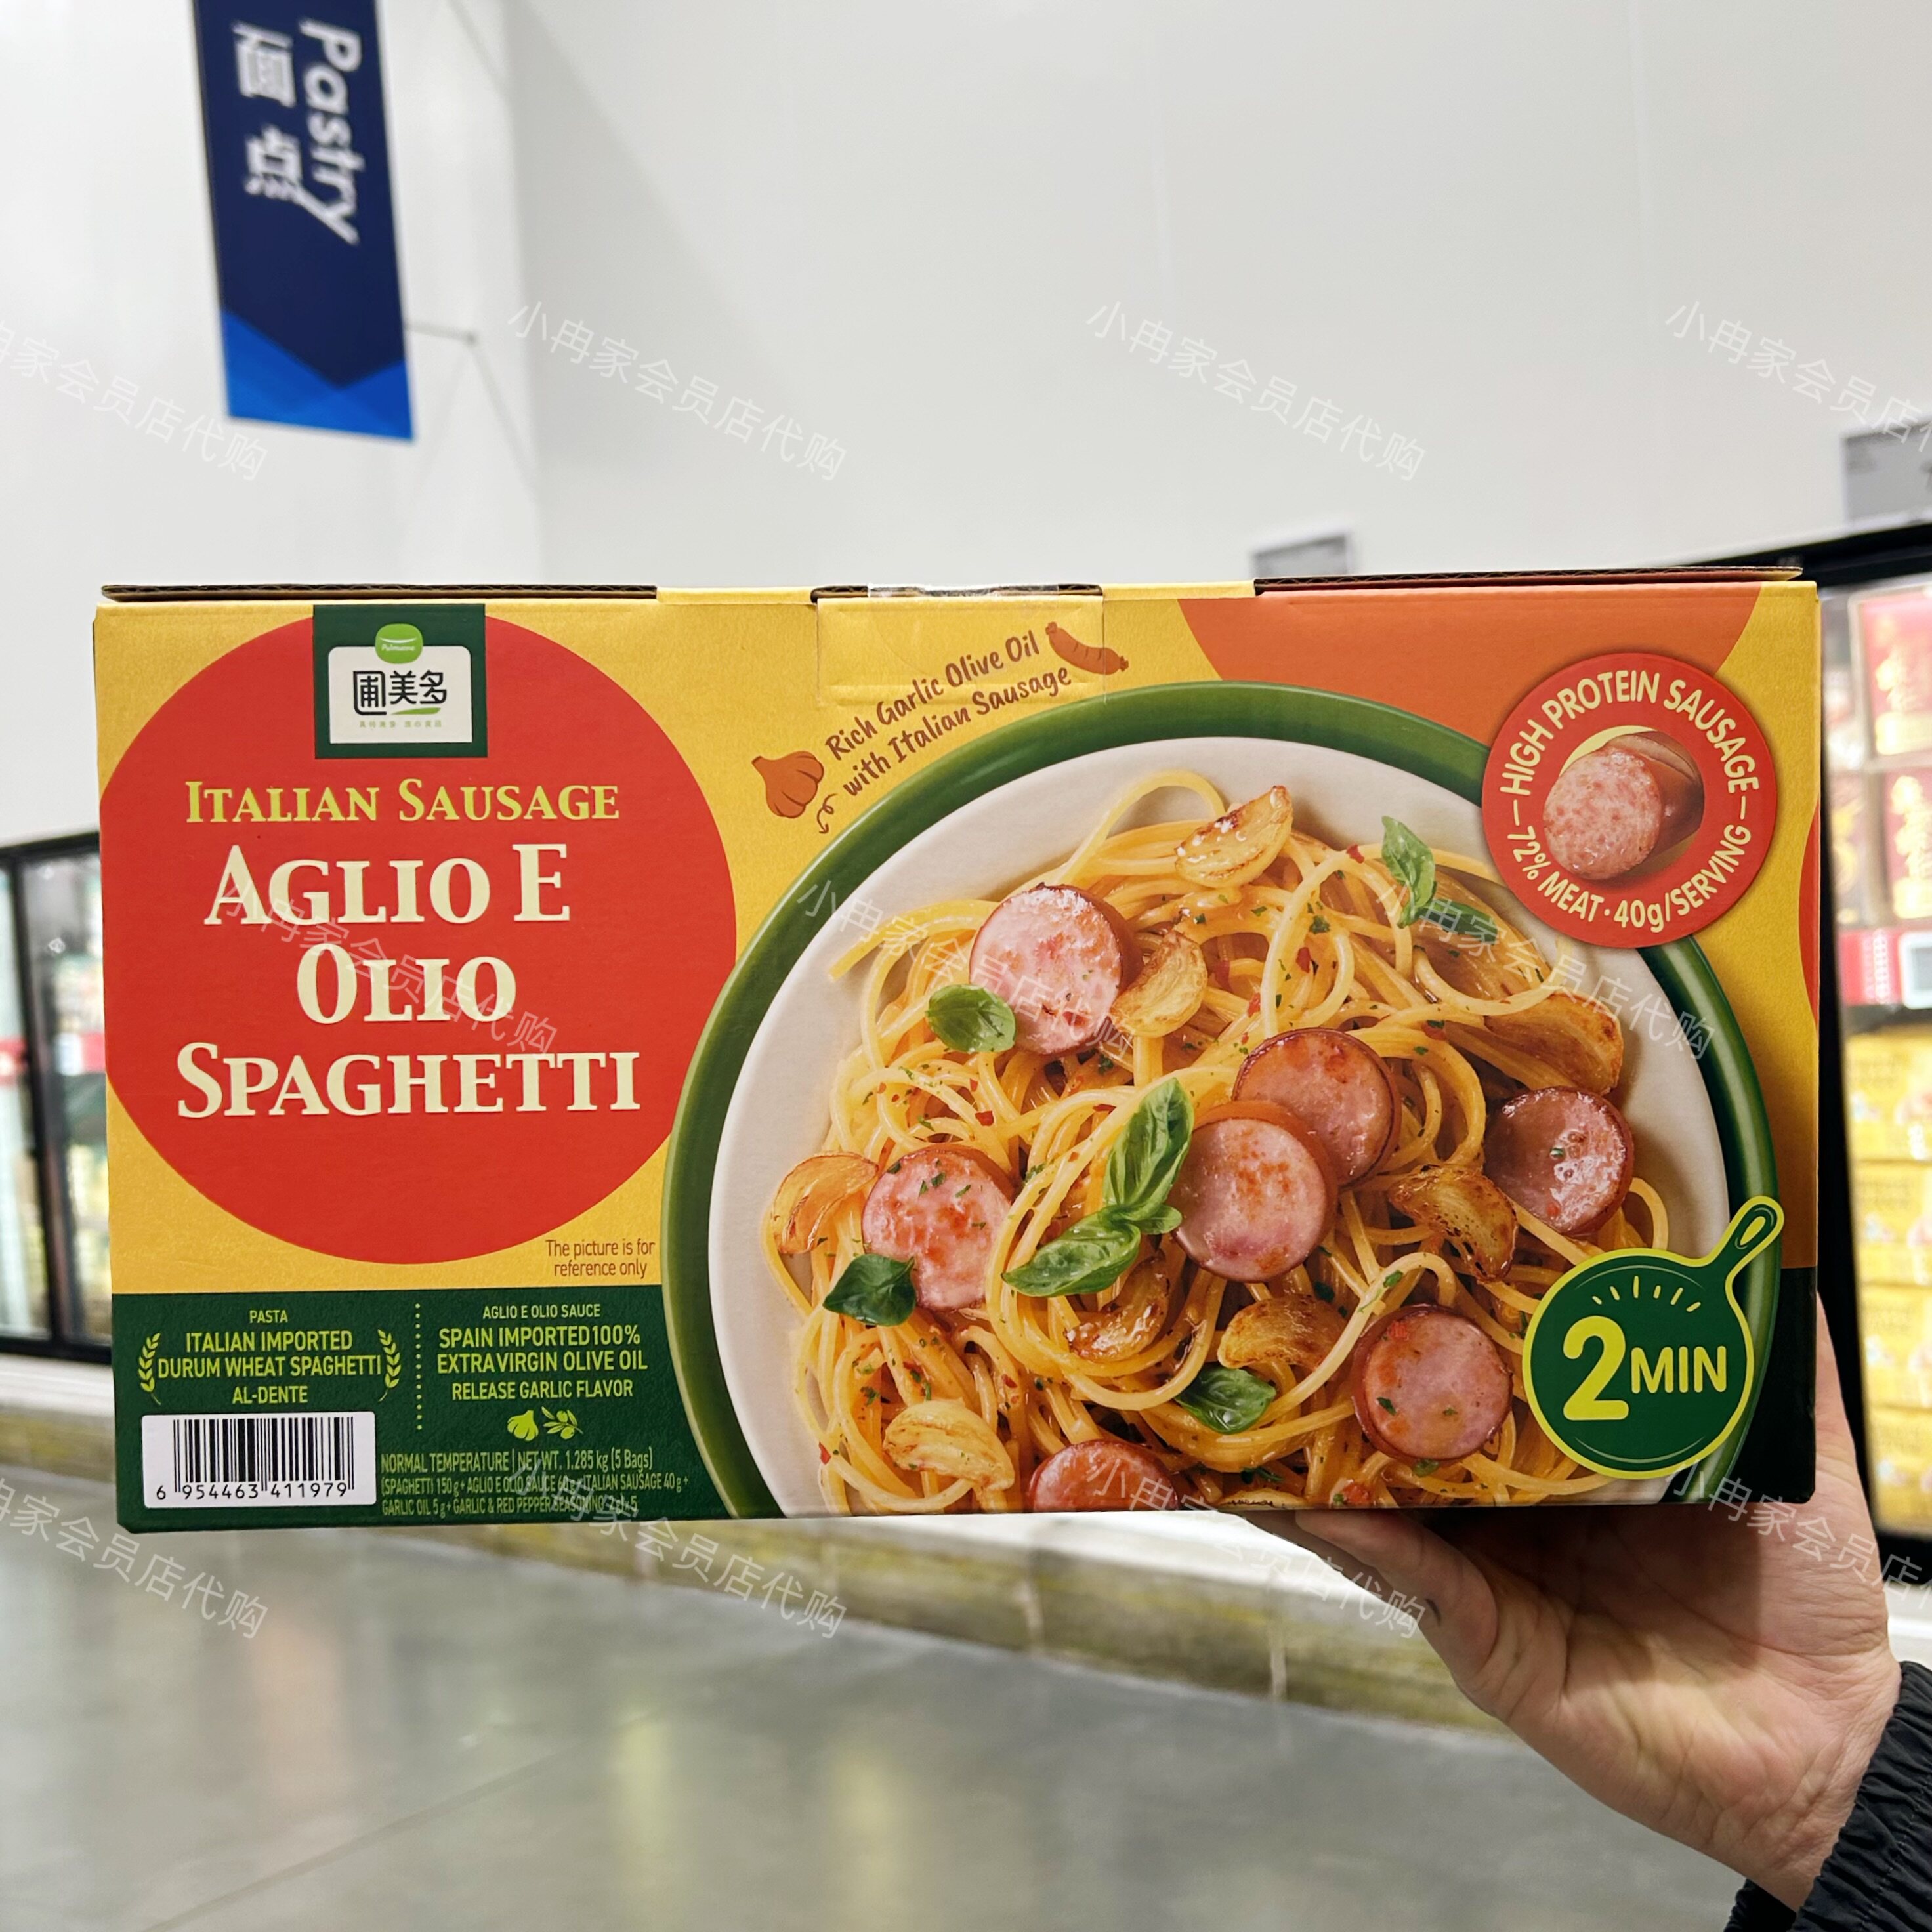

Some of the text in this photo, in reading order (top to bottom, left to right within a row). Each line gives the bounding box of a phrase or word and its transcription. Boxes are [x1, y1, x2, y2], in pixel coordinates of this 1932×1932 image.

[300, 18, 366, 245] Pastry
[353, 669, 447, 715] 圃美多
[825, 630, 1040, 761] Rich Garlic Olive Oil
[843, 667, 1071, 796] with Italian Sausage
[1500, 670, 1759, 796] HIGH PROTEIN SAUSAGE
[513, 843, 570, 921] E
[1507, 824, 1752, 933] 72% MEAT 40g/SERVING
[545, 1238, 656, 1260] The picture is for
[554, 1258, 647, 1280] reference only
[249, 1310, 288, 1323] PASTA
[483, 1303, 600, 1319] AGLIO E OLIO SAUCE
[186, 1330, 352, 1353] ITALIAN IMPORTED
[439, 1324, 640, 1348] SPAIN IMPORTED 100%
[158, 1355, 381, 1378] DURUM WHEAT SPAGHETTI
[438, 1350, 648, 1374] EXTRA VIRGIN OLIVE OIL
[232, 1385, 308, 1404] AL-DENTE
[453, 1379, 633, 1400] RELEASE GARLIC FLAVOR
[381, 1453, 428, 1473] NORMAL
[429, 1451, 509, 1473] TEMPERATURE
[518, 1450, 539, 1471] NET
[566, 1449, 593, 1470] 1.285
[596, 1449, 608, 1473] kg
[611, 1446, 621, 1471] (5
[624, 1446, 652, 1473] Bags)
[381, 1477, 434, 1497] (SPAGHETTI
[467, 1476, 493, 1494] AGLIO
[496, 1477, 501, 1493] E
[503, 1475, 524, 1493] OLIO
[526, 1475, 555, 1492] SAUCE
[583, 1474, 618, 1492] ITALIAN
[620, 1473, 662, 1490] SAUSAGE
[382, 1499, 414, 1516] GARLIC
[417, 1498, 431, 1515] OIL
[453, 1498, 486, 1515] GARLIC
[488, 1497, 495, 1514] &
[497, 1496, 514, 1514] RED
[517, 1496, 551, 1513] PEPPER
